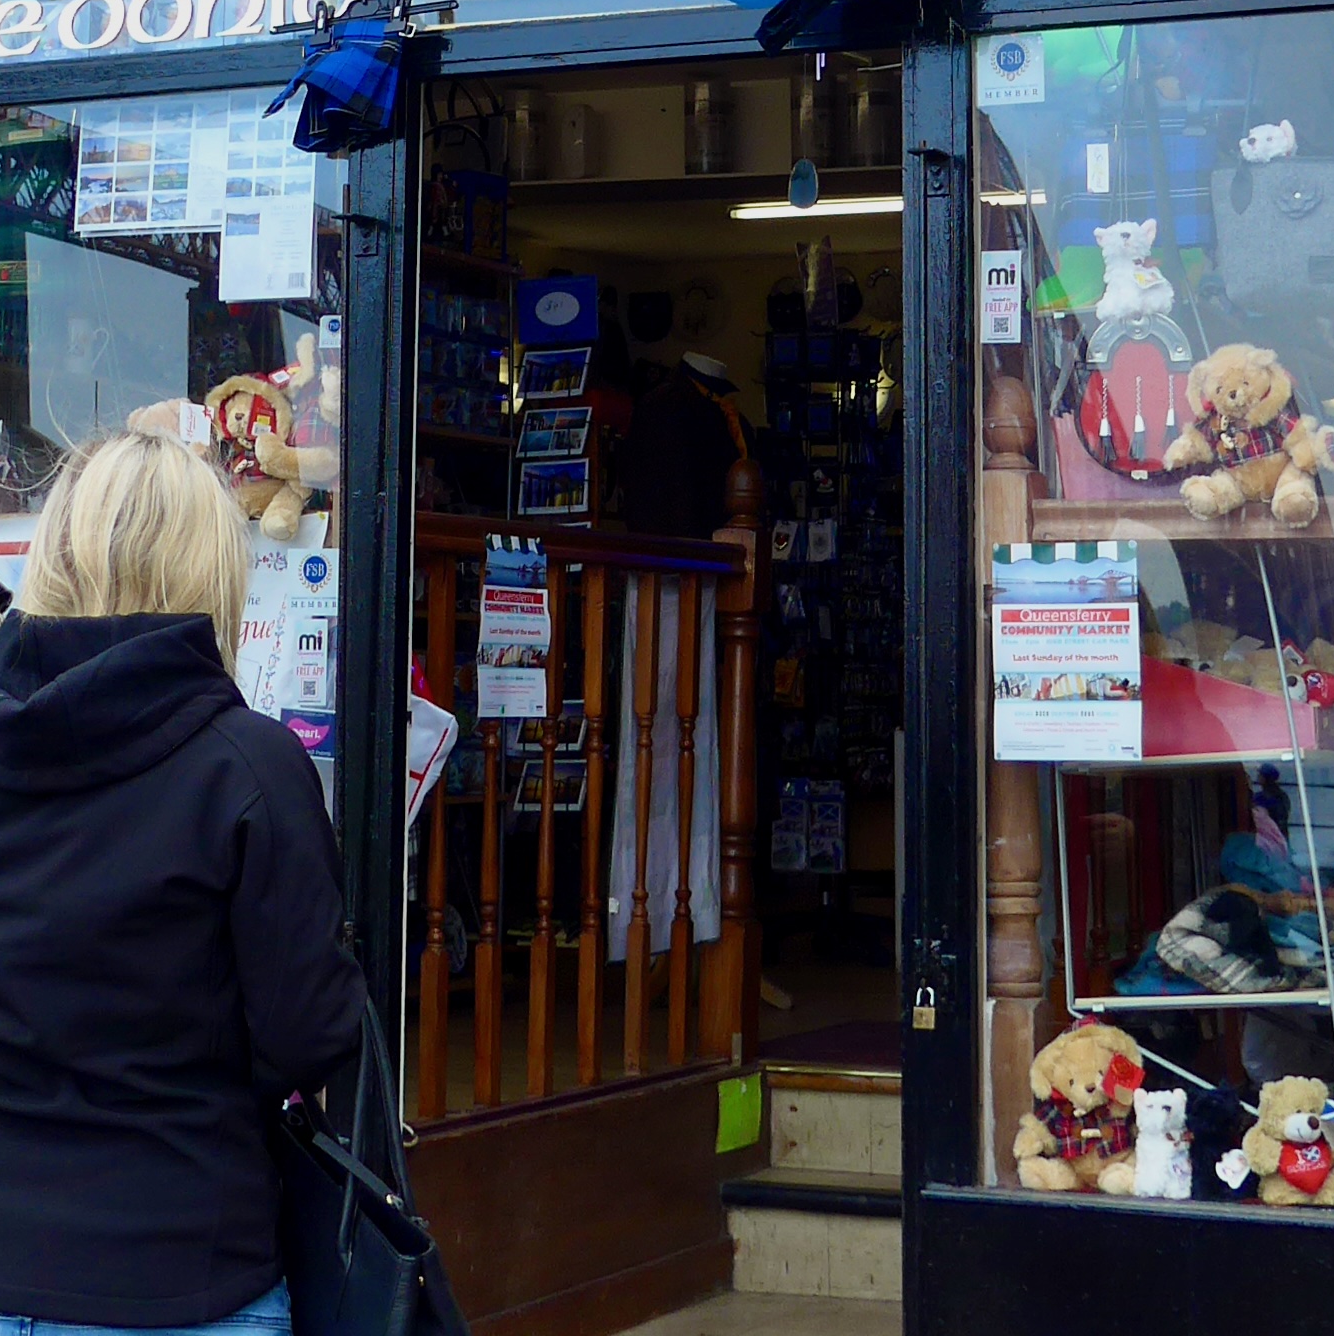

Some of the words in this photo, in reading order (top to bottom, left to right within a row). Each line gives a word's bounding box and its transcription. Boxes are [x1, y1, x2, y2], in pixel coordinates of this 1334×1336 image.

[1000, 50, 1022, 65] FSB
[985, 88, 1039, 99] MEMBER
[984, 302, 1001, 312] FREE
[1003, 302, 1018, 312] APP
[306, 563, 325, 577] FSB
[494, 590, 534, 604] Queensferry
[1019, 609, 1111, 622] Queensferry
[1001, 624, 1073, 636] COMMUNITY
[1078, 624, 1130, 636] MARKET
[1013, 654, 1030, 662] Last
[1032, 654, 1063, 663] Sunday
[1065, 654, 1073, 662] of
[1075, 654, 1089, 662] the
[1091, 654, 1119, 662] month
[296, 666, 311, 676] FREE
[313, 666, 324, 676] APP
